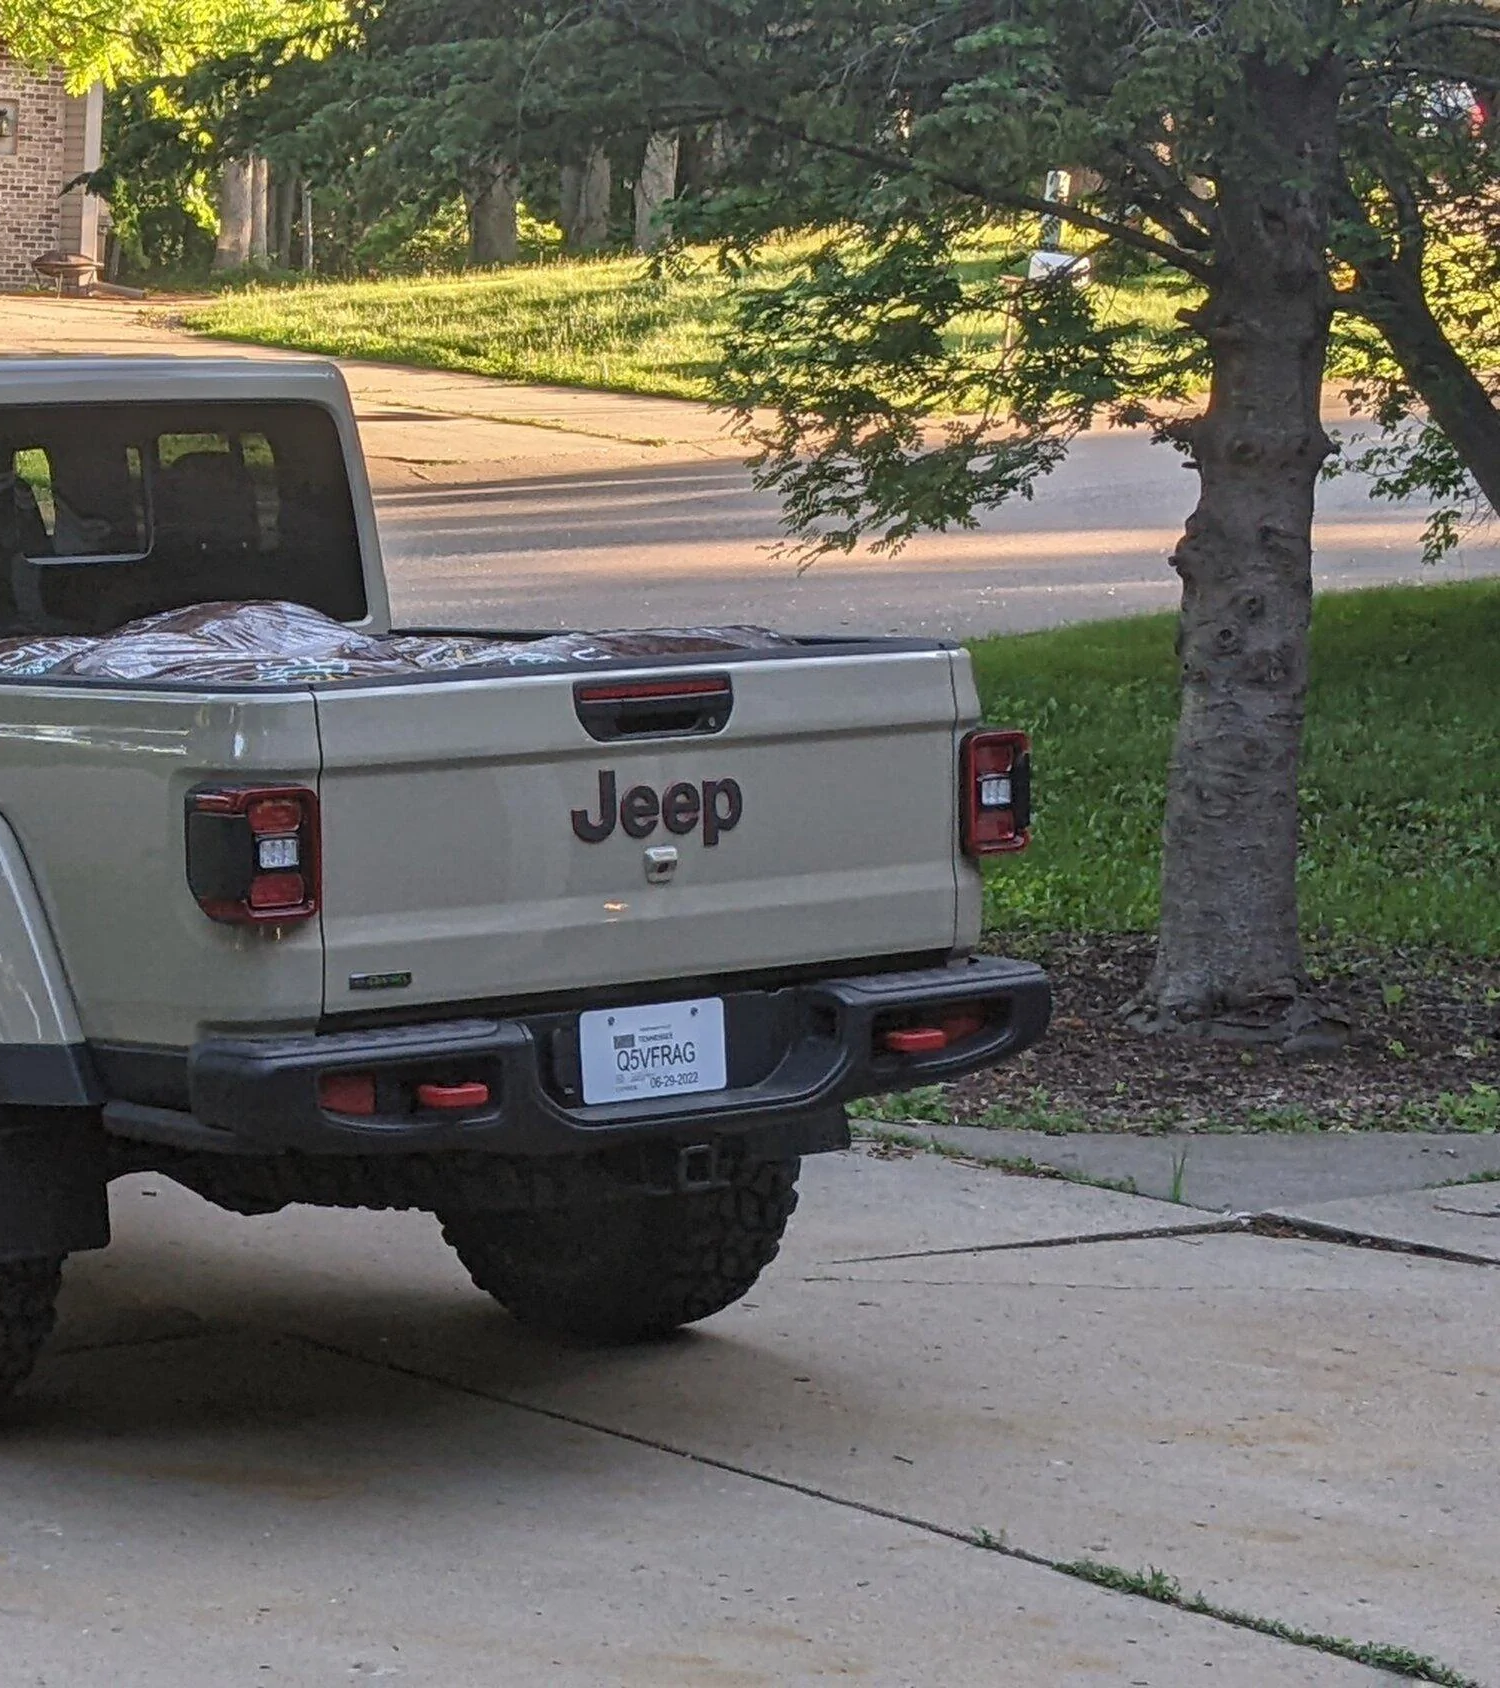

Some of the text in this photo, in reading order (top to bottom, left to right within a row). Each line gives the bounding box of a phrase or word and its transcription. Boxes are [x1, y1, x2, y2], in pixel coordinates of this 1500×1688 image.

[570, 768, 743, 847] Jeep
[616, 1041, 696, 1072] Q5VFRAG
[650, 1071, 700, 1089] 06-29-2022
